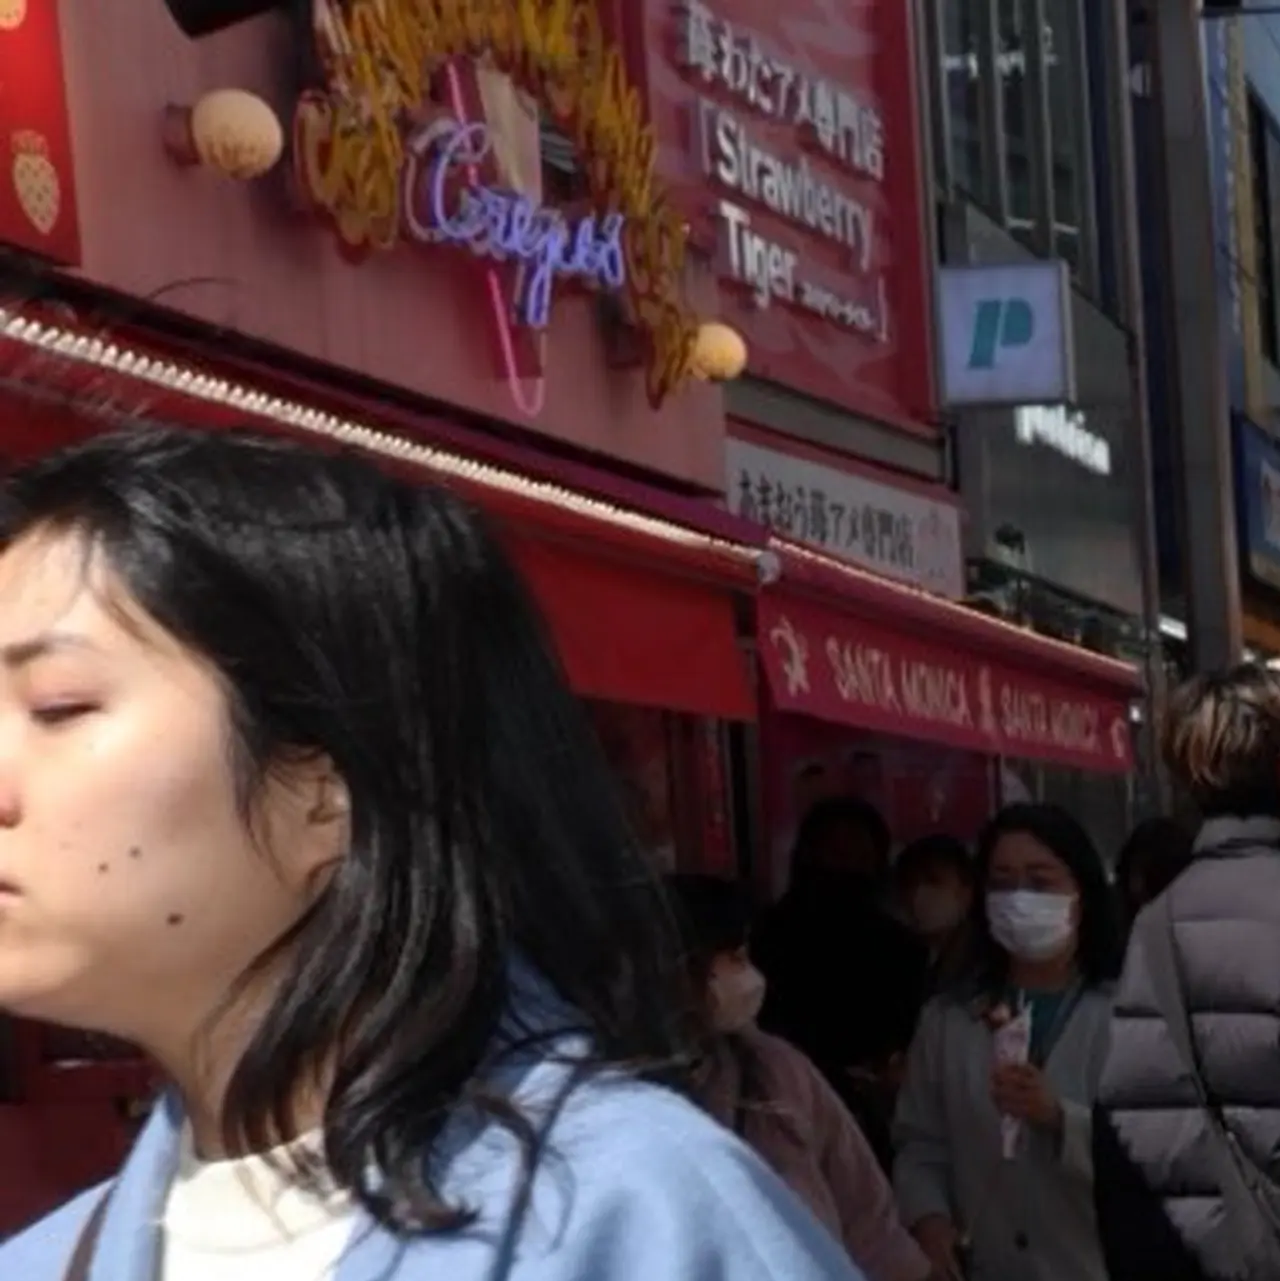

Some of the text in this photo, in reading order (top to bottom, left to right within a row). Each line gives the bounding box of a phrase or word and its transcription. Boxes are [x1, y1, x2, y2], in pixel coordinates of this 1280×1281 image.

[716, 110, 876, 272] Strawberry
[718, 200, 800, 310] Tiger
[824, 636, 902, 715] SANTA
[901, 660, 974, 728] MONICA
